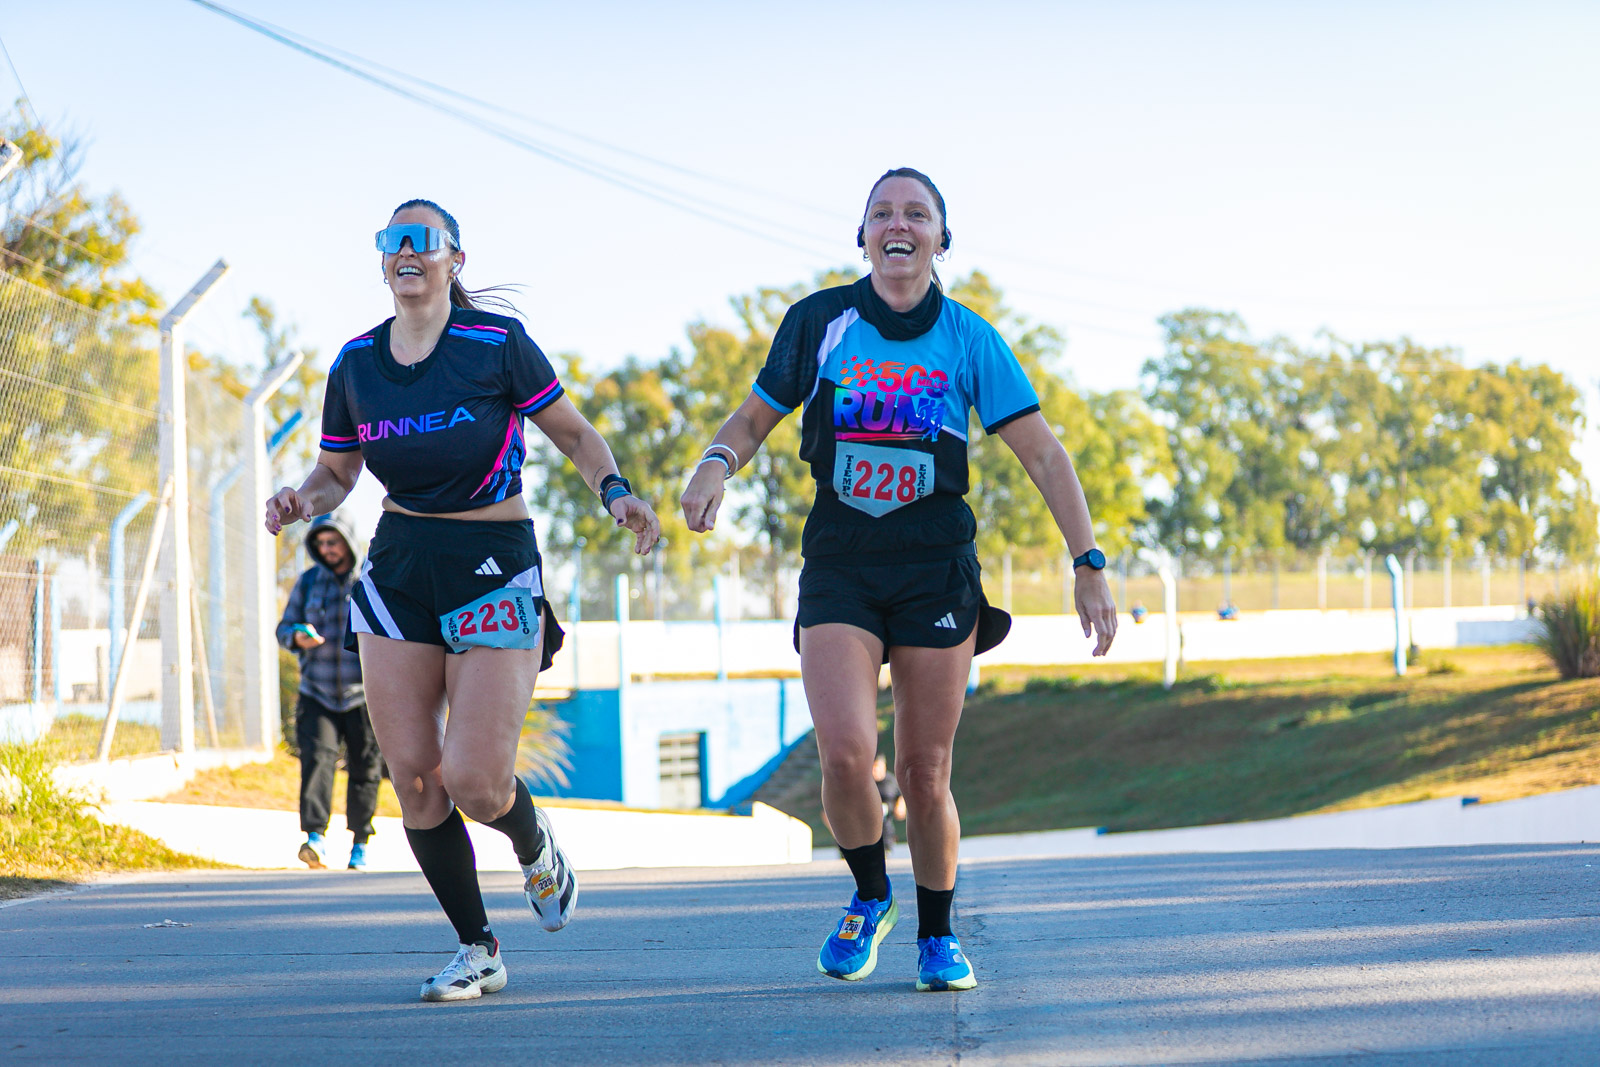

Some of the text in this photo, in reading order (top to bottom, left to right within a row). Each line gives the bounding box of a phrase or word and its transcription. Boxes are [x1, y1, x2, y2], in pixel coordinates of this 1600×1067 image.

[357, 406, 476, 443] RUNNEA
[852, 459, 917, 503] 228
[457, 599, 520, 637] 223
[515, 596, 530, 635] EXACTO
[538, 877, 553, 890] 223
[844, 922, 859, 932] 228
